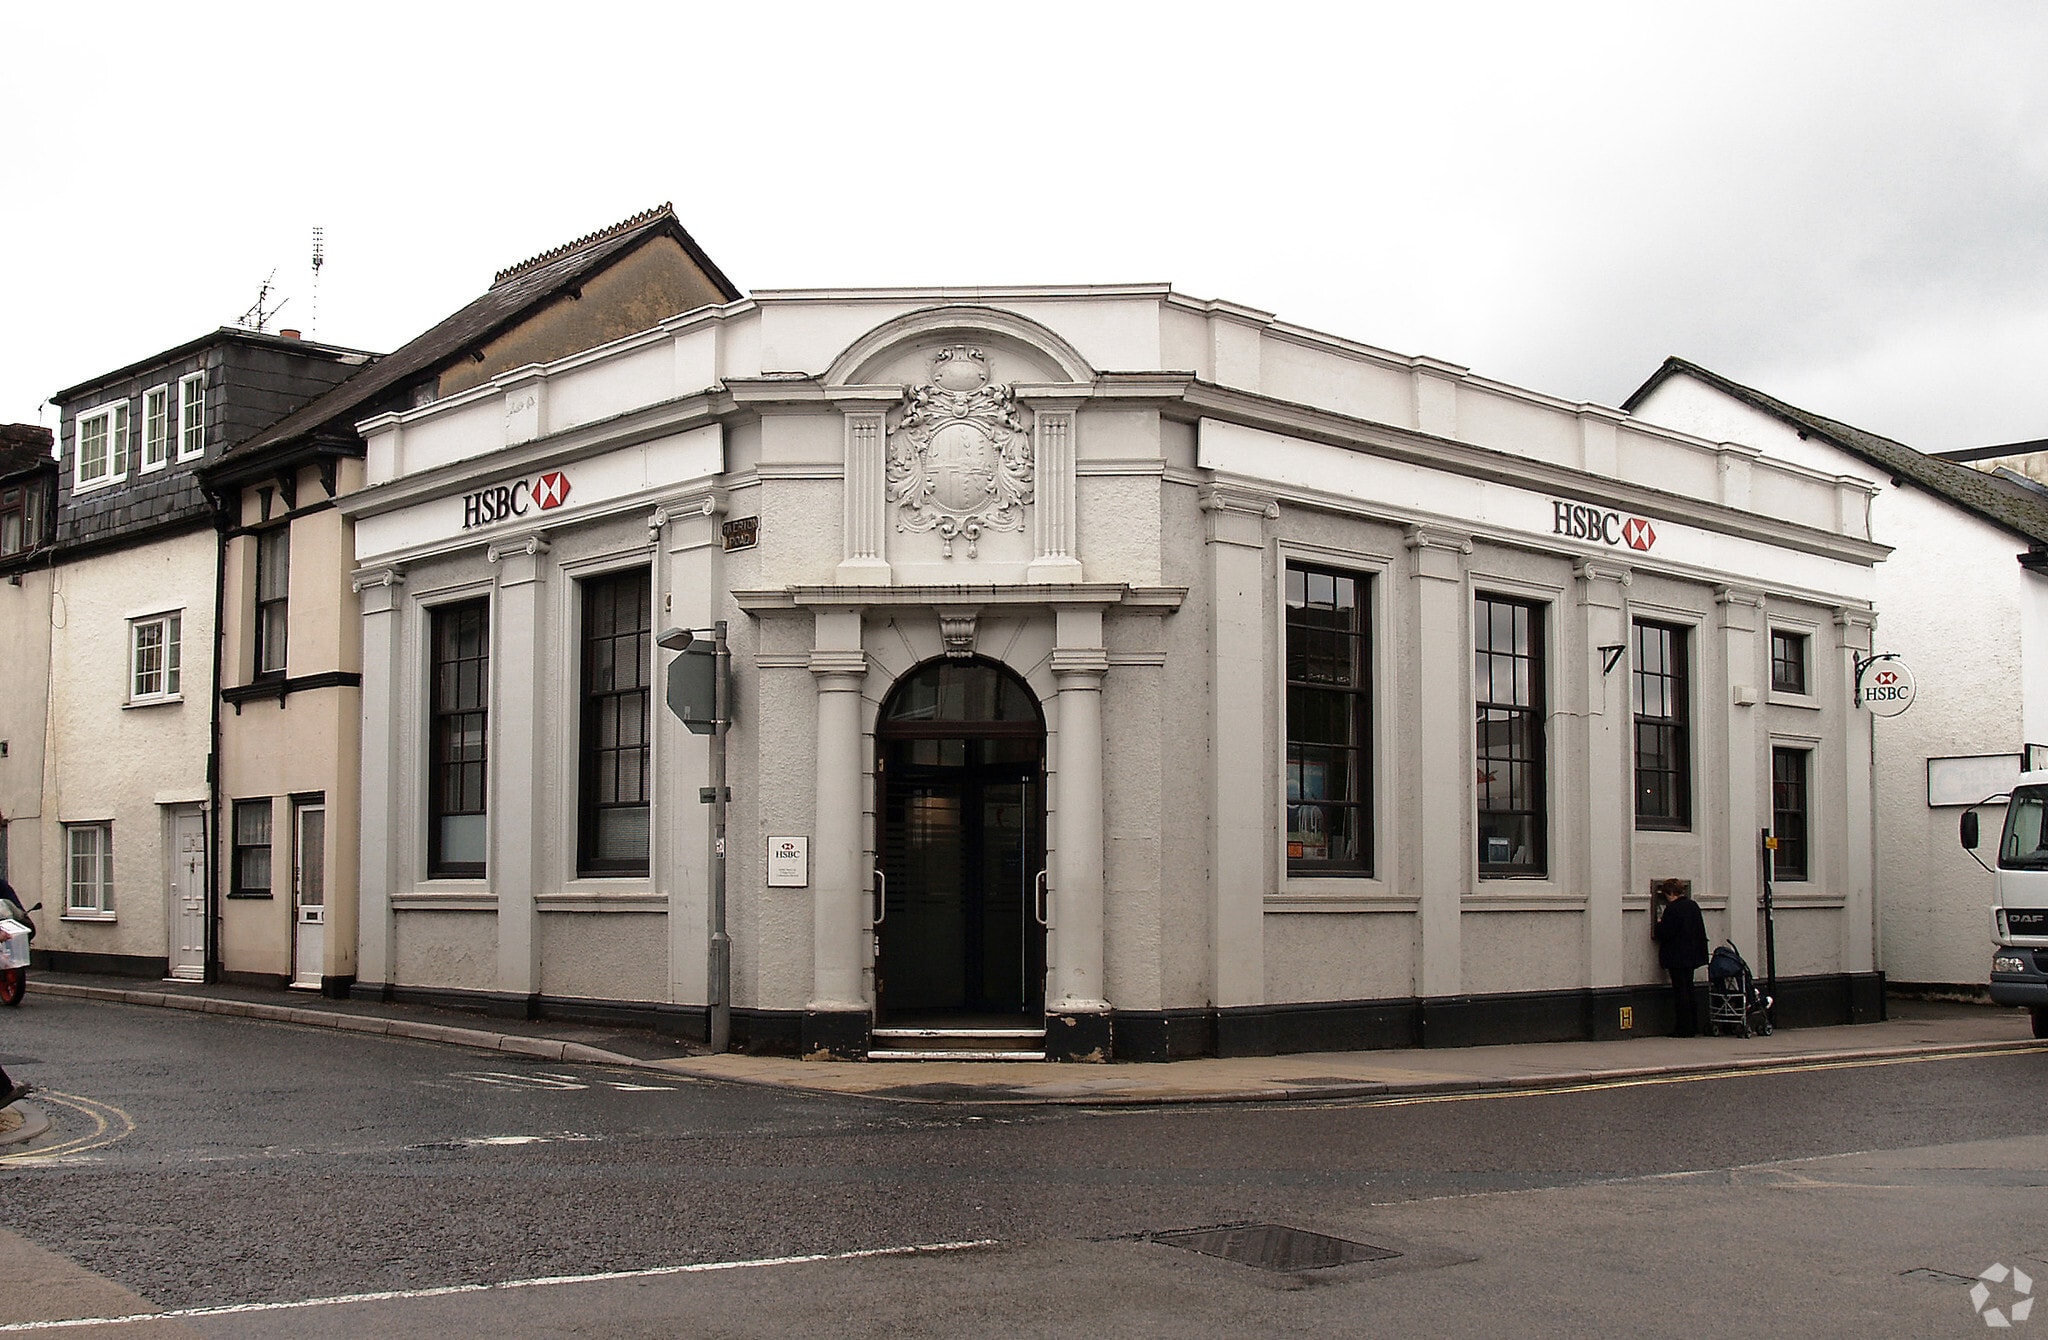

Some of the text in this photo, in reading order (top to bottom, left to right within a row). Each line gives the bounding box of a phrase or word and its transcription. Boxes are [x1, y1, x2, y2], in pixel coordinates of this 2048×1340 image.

[462, 479, 529, 529] HSBC
[1552, 500, 1620, 546] HSBC
[1865, 686, 1909, 701] HSBC
[775, 850, 801, 859] HSBC
[2009, 914, 2045, 923] DAF
[1621, 1009, 1631, 1027] H
